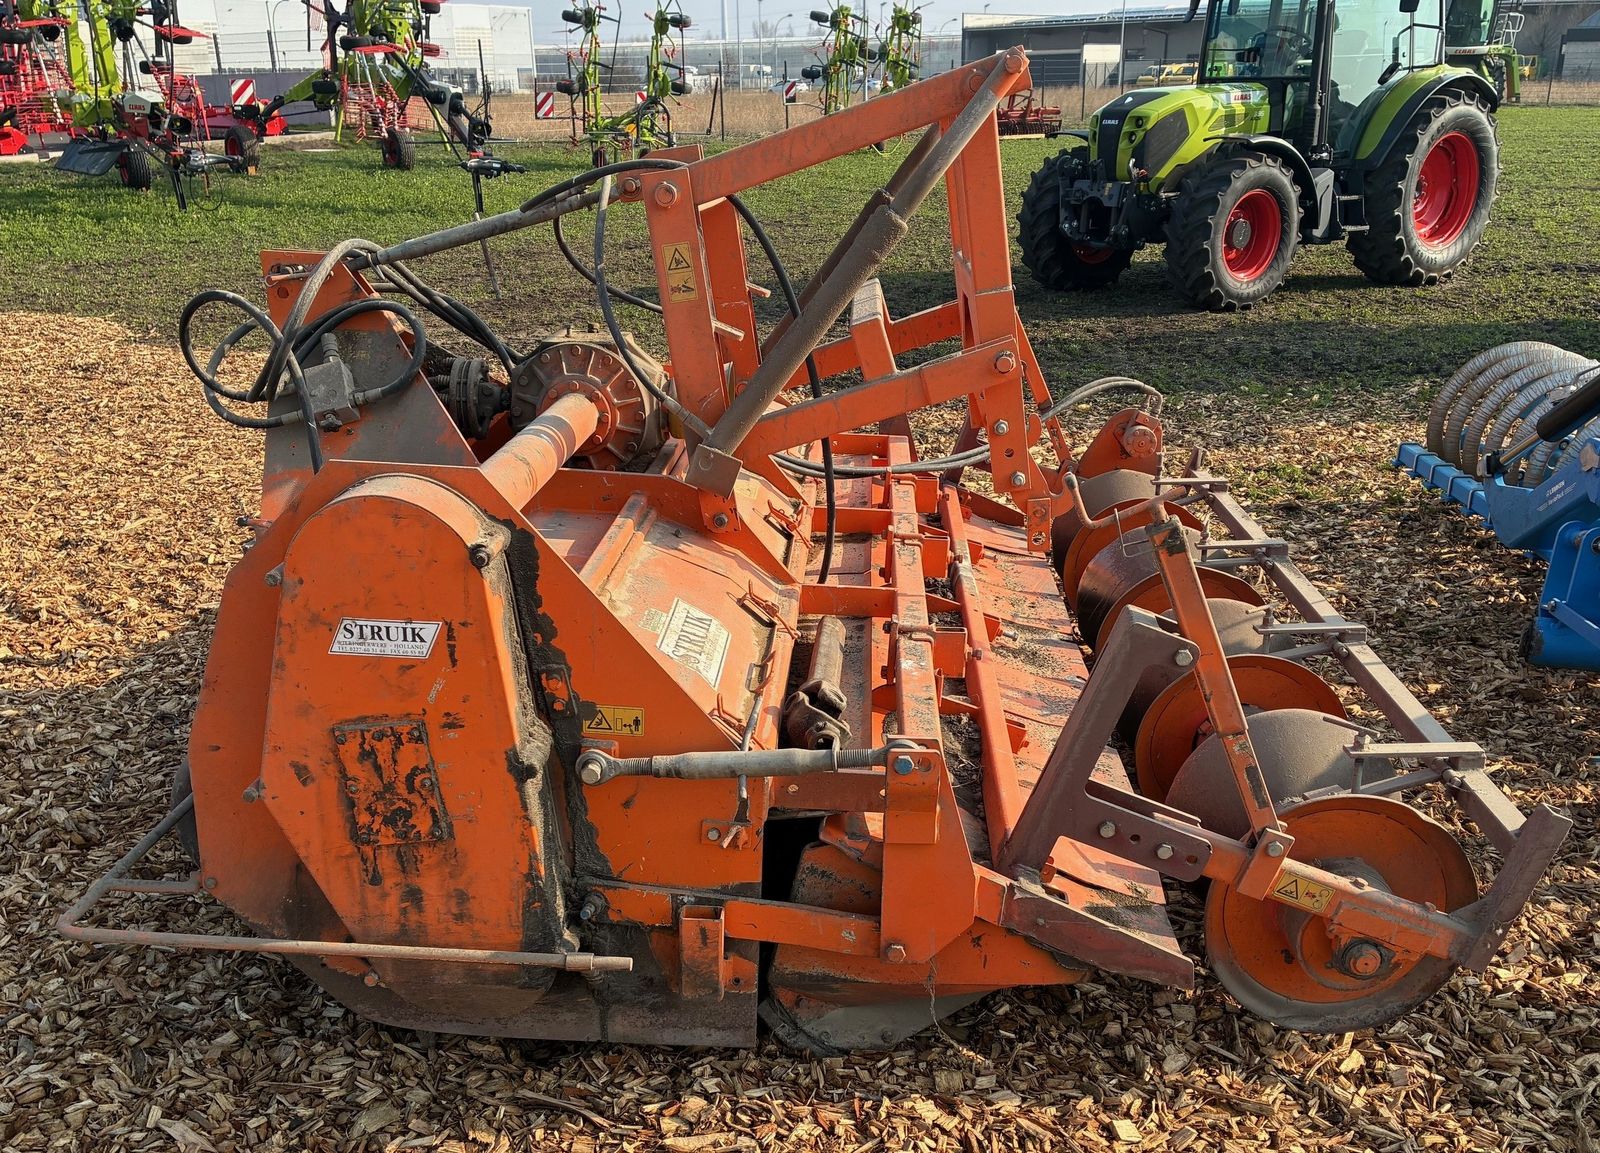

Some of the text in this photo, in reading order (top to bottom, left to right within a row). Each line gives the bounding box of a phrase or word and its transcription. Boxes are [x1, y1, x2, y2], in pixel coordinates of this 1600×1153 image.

[1233, 93, 1252, 101] CLAAS
[128, 103, 146, 111] CLAAS
[343, 622, 427, 643] STRUIK
[671, 609, 713, 665] STRUIK
